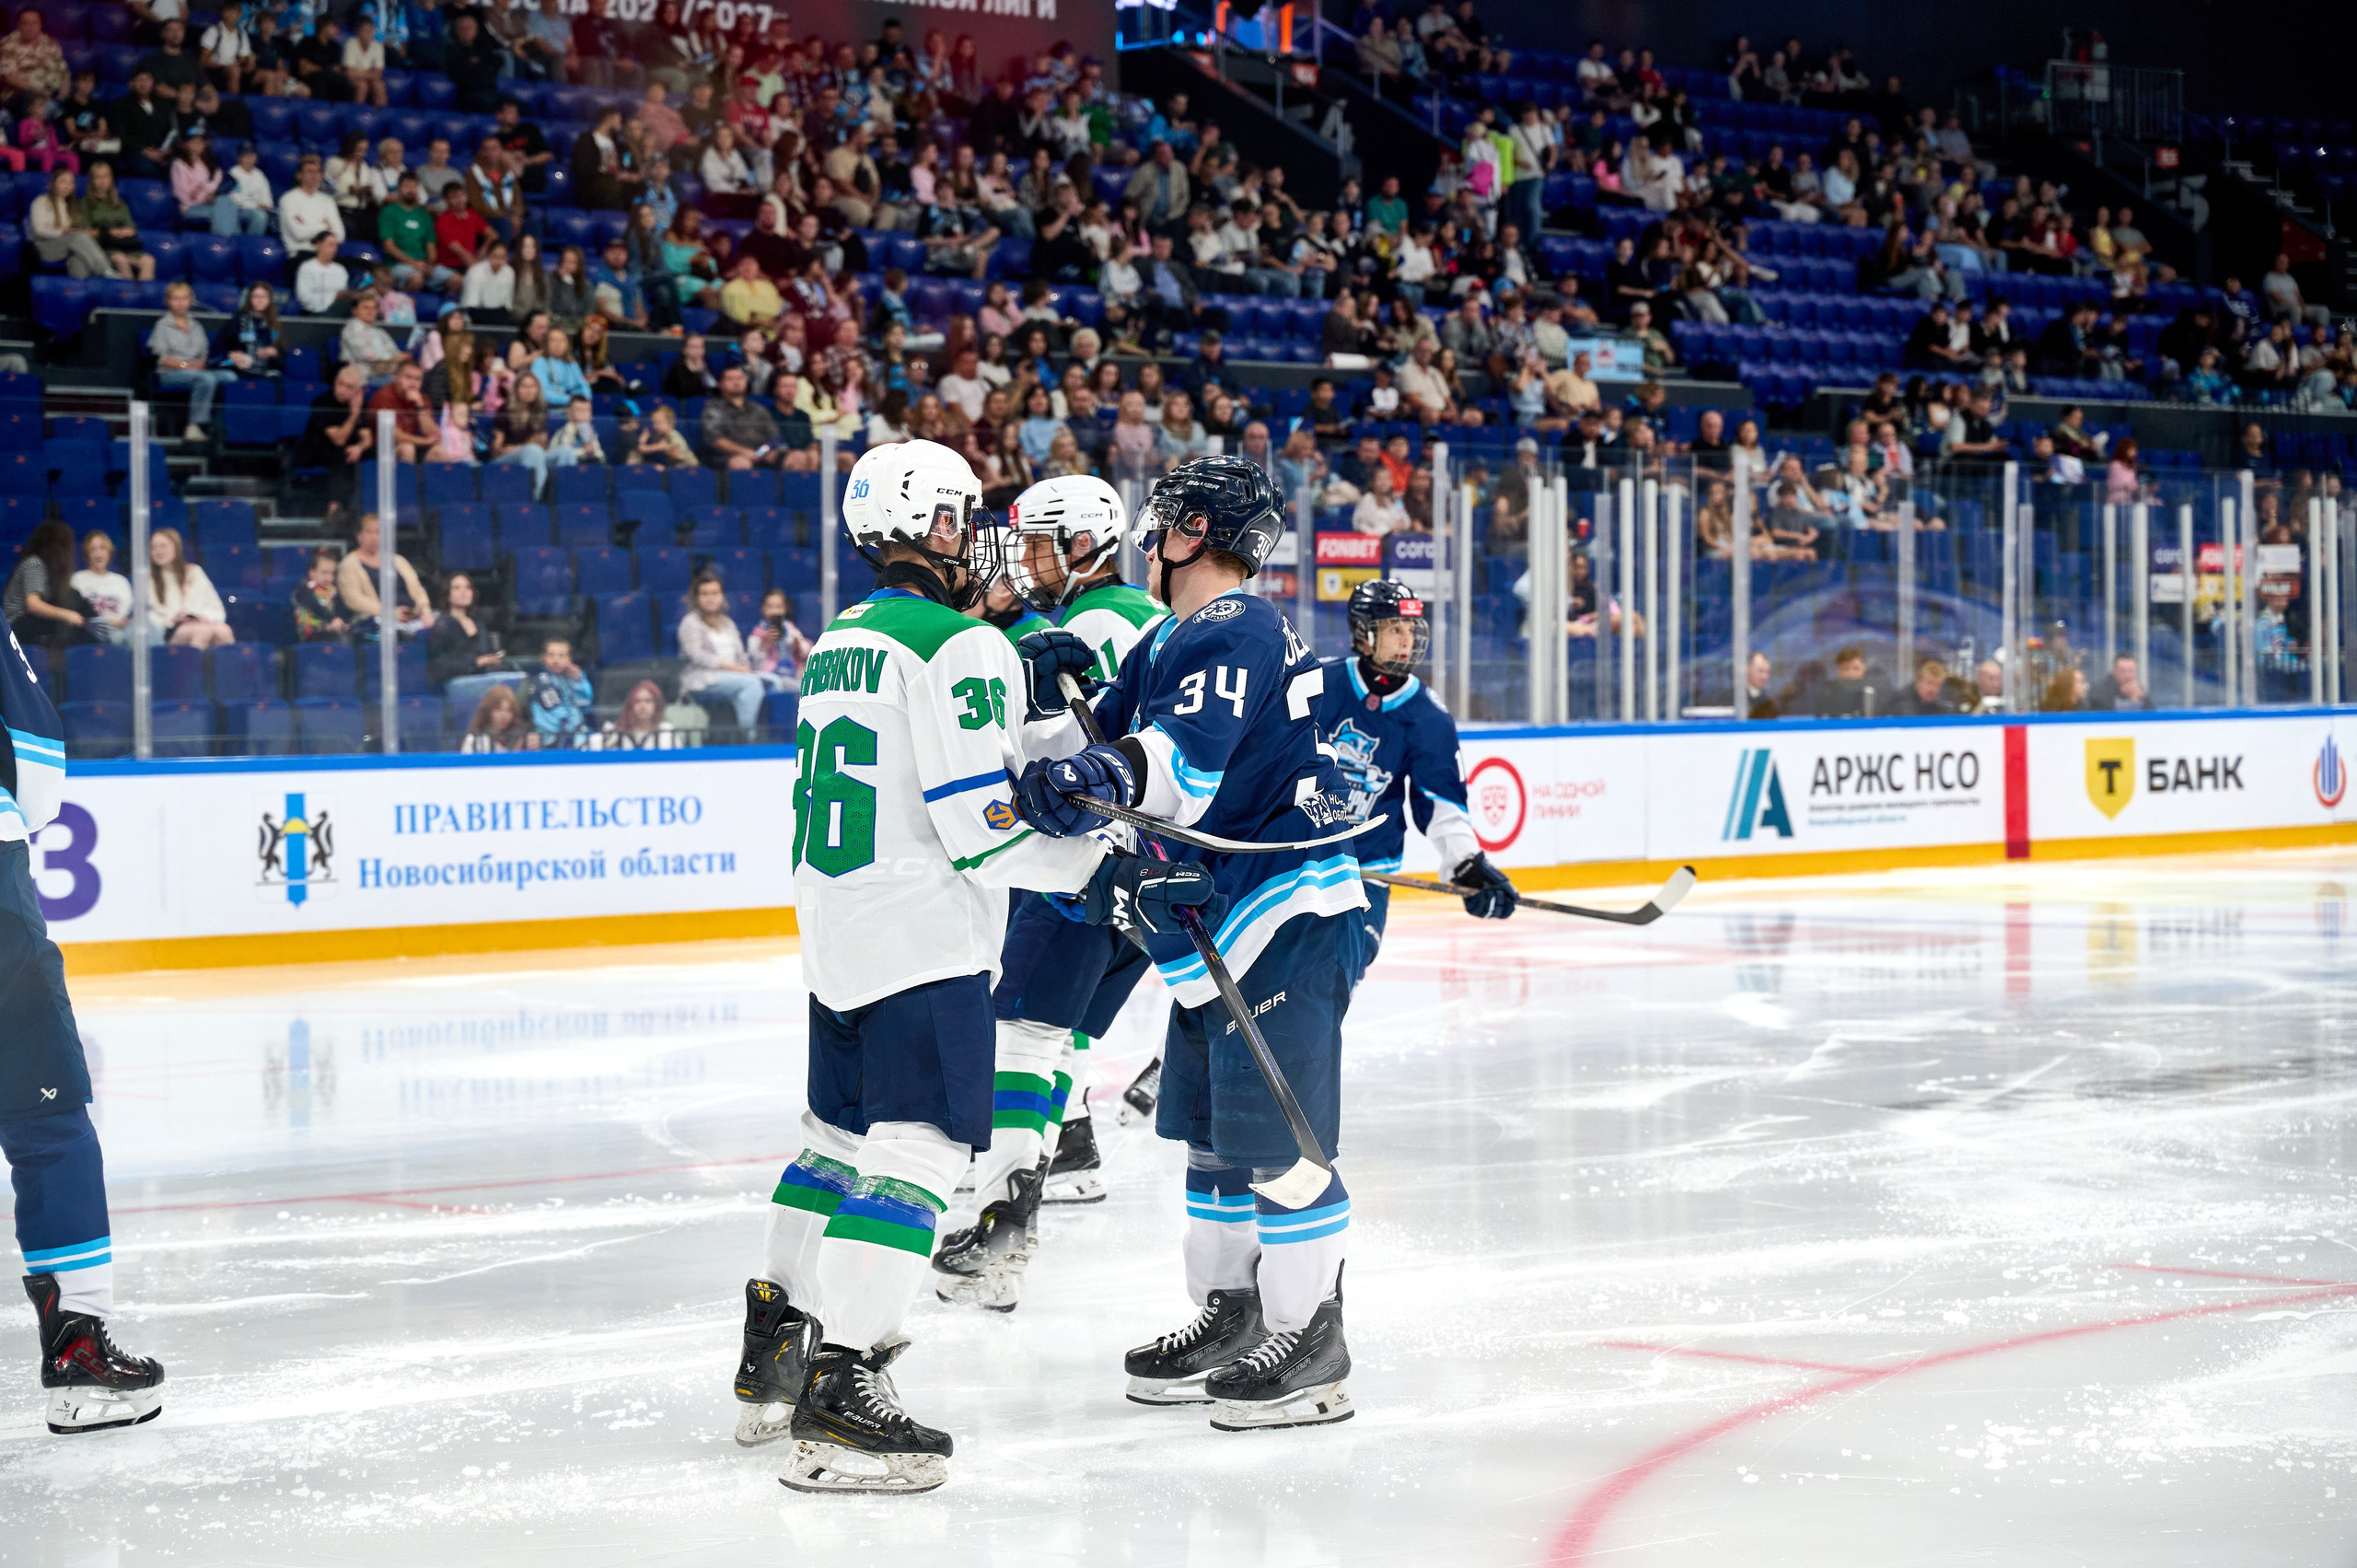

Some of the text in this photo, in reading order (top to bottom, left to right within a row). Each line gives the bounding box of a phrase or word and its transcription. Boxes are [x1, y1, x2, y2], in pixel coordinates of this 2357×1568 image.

[851, 479, 869, 499] 36
[936, 487, 963, 497] CCM
[943, 557, 960, 565] CCM
[951, 677, 1006, 730] 36
[1174, 665, 1248, 719] 34
[1809, 750, 1980, 796] АРЖС НСО
[2147, 756, 2244, 793] БАНК
[394, 796, 703, 834] ПРАВИТЕЛЬСТВО
[358, 847, 737, 891] Новосибирской области
[1225, 991, 1287, 1036] BUER
[1187, 1342, 1222, 1365] BAUER
[1281, 1357, 1312, 1385] BAUER
[842, 1411, 882, 1430] BAUER
